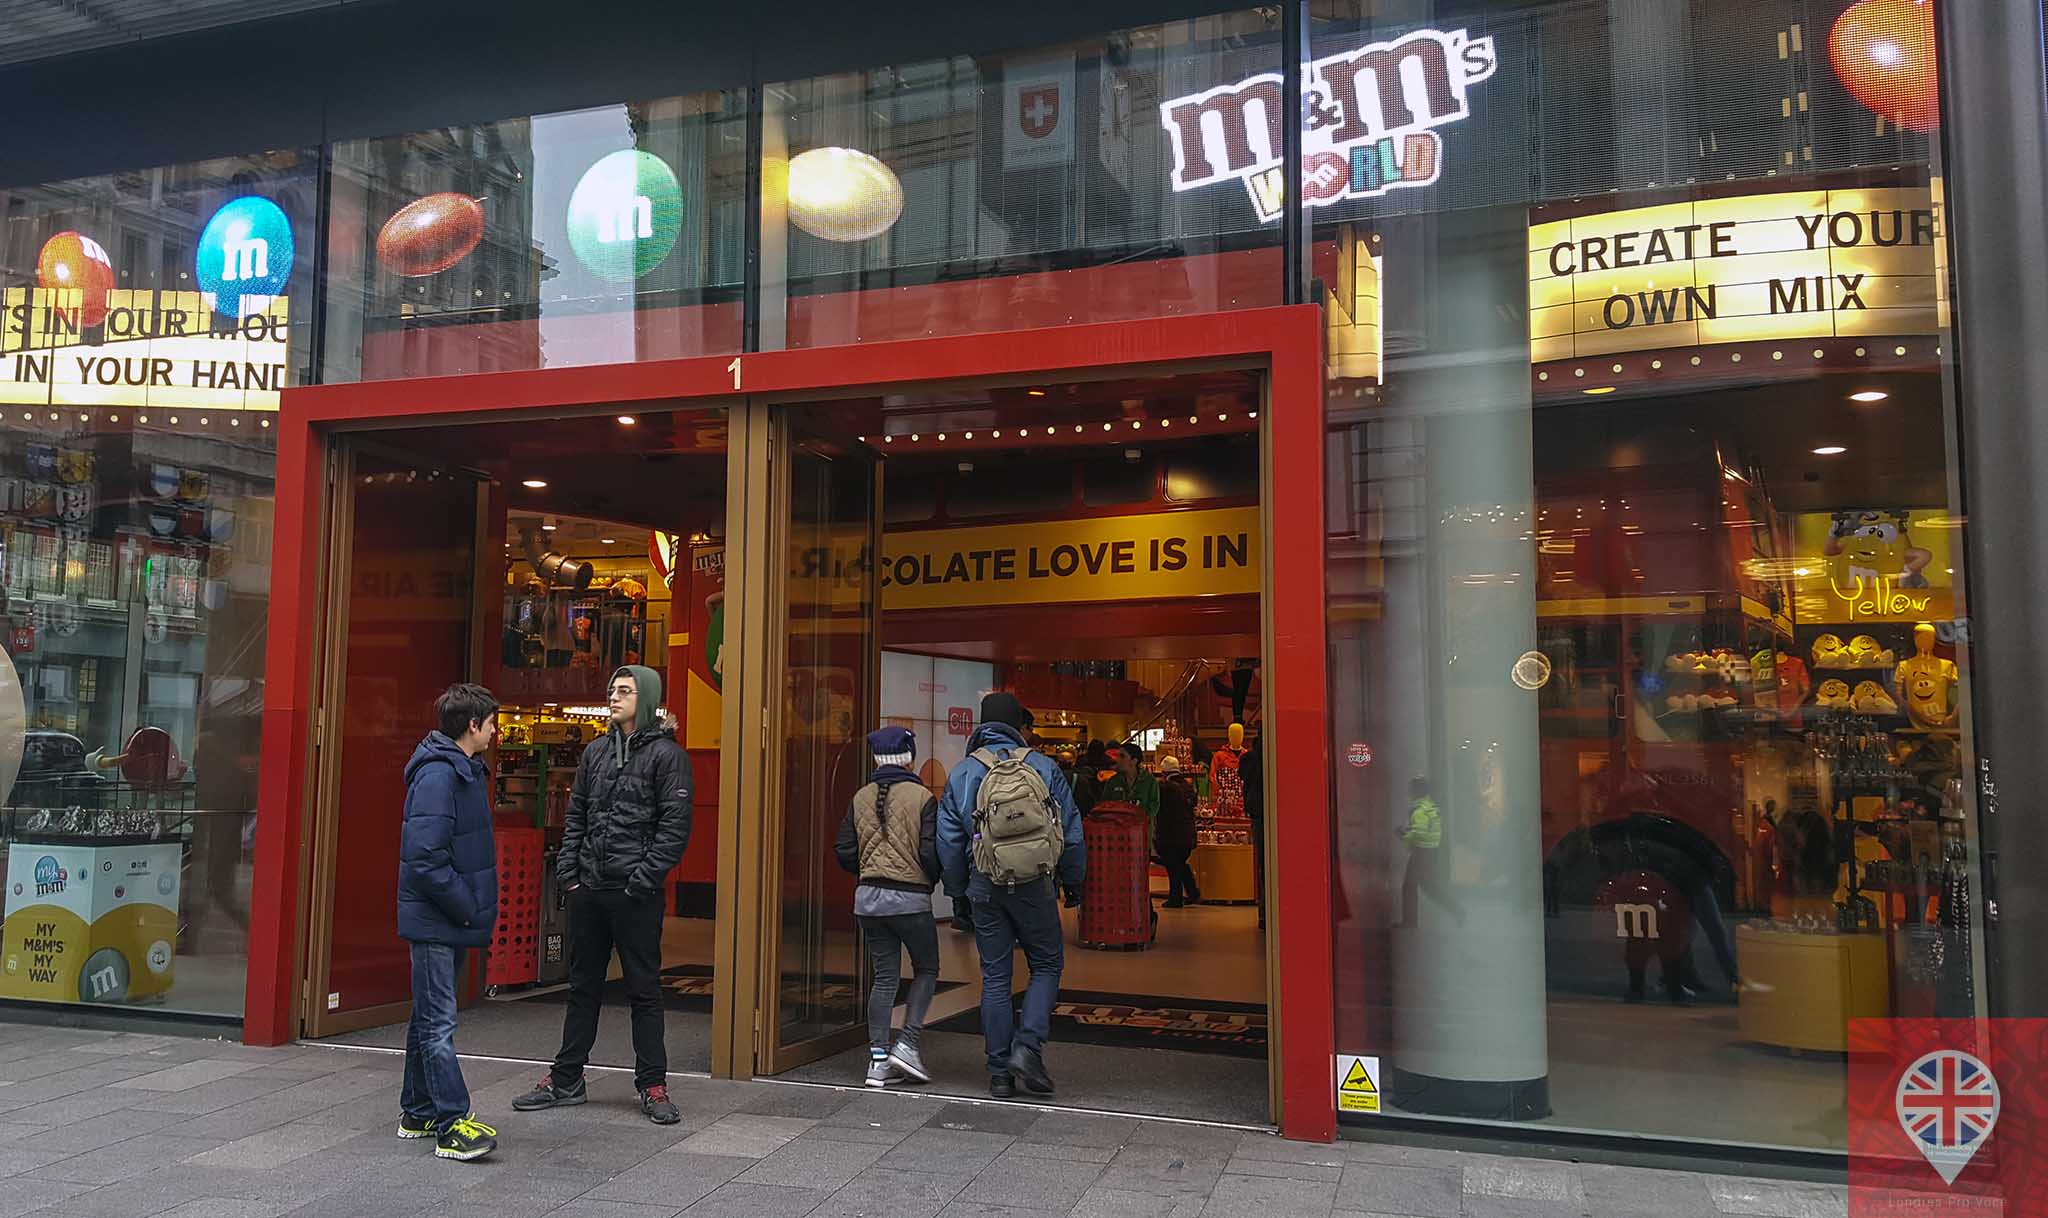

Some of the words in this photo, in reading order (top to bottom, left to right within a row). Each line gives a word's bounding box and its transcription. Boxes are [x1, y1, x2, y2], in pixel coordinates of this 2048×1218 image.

[1549, 221, 1738, 277] CREATE
[1795, 209, 1935, 250] YOUR
[1603, 283, 1717, 330] OWN
[1769, 273, 1867, 315] MIX
[44, 306, 79, 335] IN
[15, 354, 49, 383] IN
[76, 356, 174, 386] YOUR
[727, 357, 741, 390] 1
[1028, 539, 1136, 579] LOVE
[1149, 536, 1188, 572] IS
[1203, 532, 1248, 569] IN
[1831, 575, 1931, 621] Yellow
[950, 711, 970, 731] Gift
[36, 923, 57, 937] MY
[23, 938, 65, 953] M&M'S
[34, 954, 54, 968] MY
[28, 969, 58, 984] WAY
